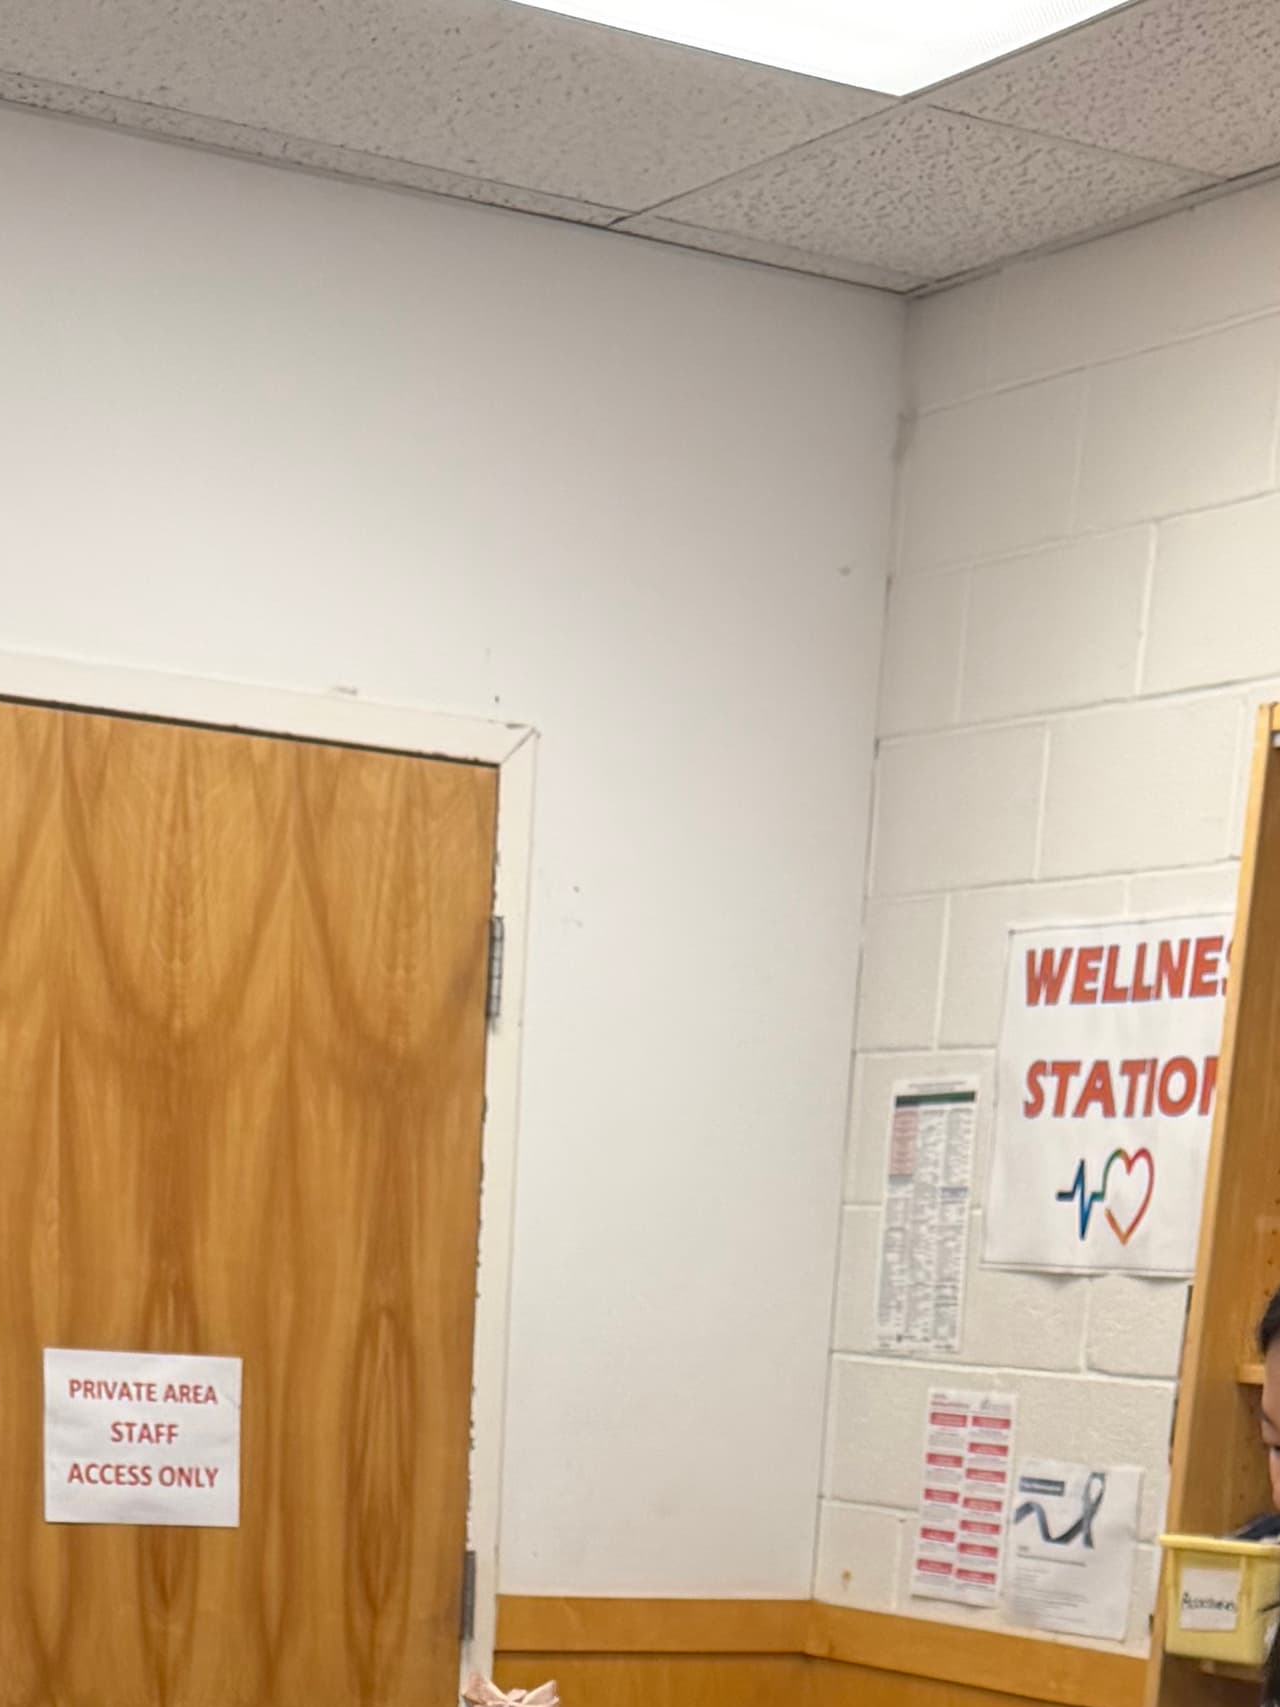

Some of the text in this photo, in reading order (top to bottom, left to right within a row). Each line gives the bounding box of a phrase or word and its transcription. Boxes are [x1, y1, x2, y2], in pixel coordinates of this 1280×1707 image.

[67, 1378, 219, 1405] PRIVATE AREA
[110, 1421, 179, 1444] STAFF
[67, 1464, 220, 1490] ACCESS ONLY
